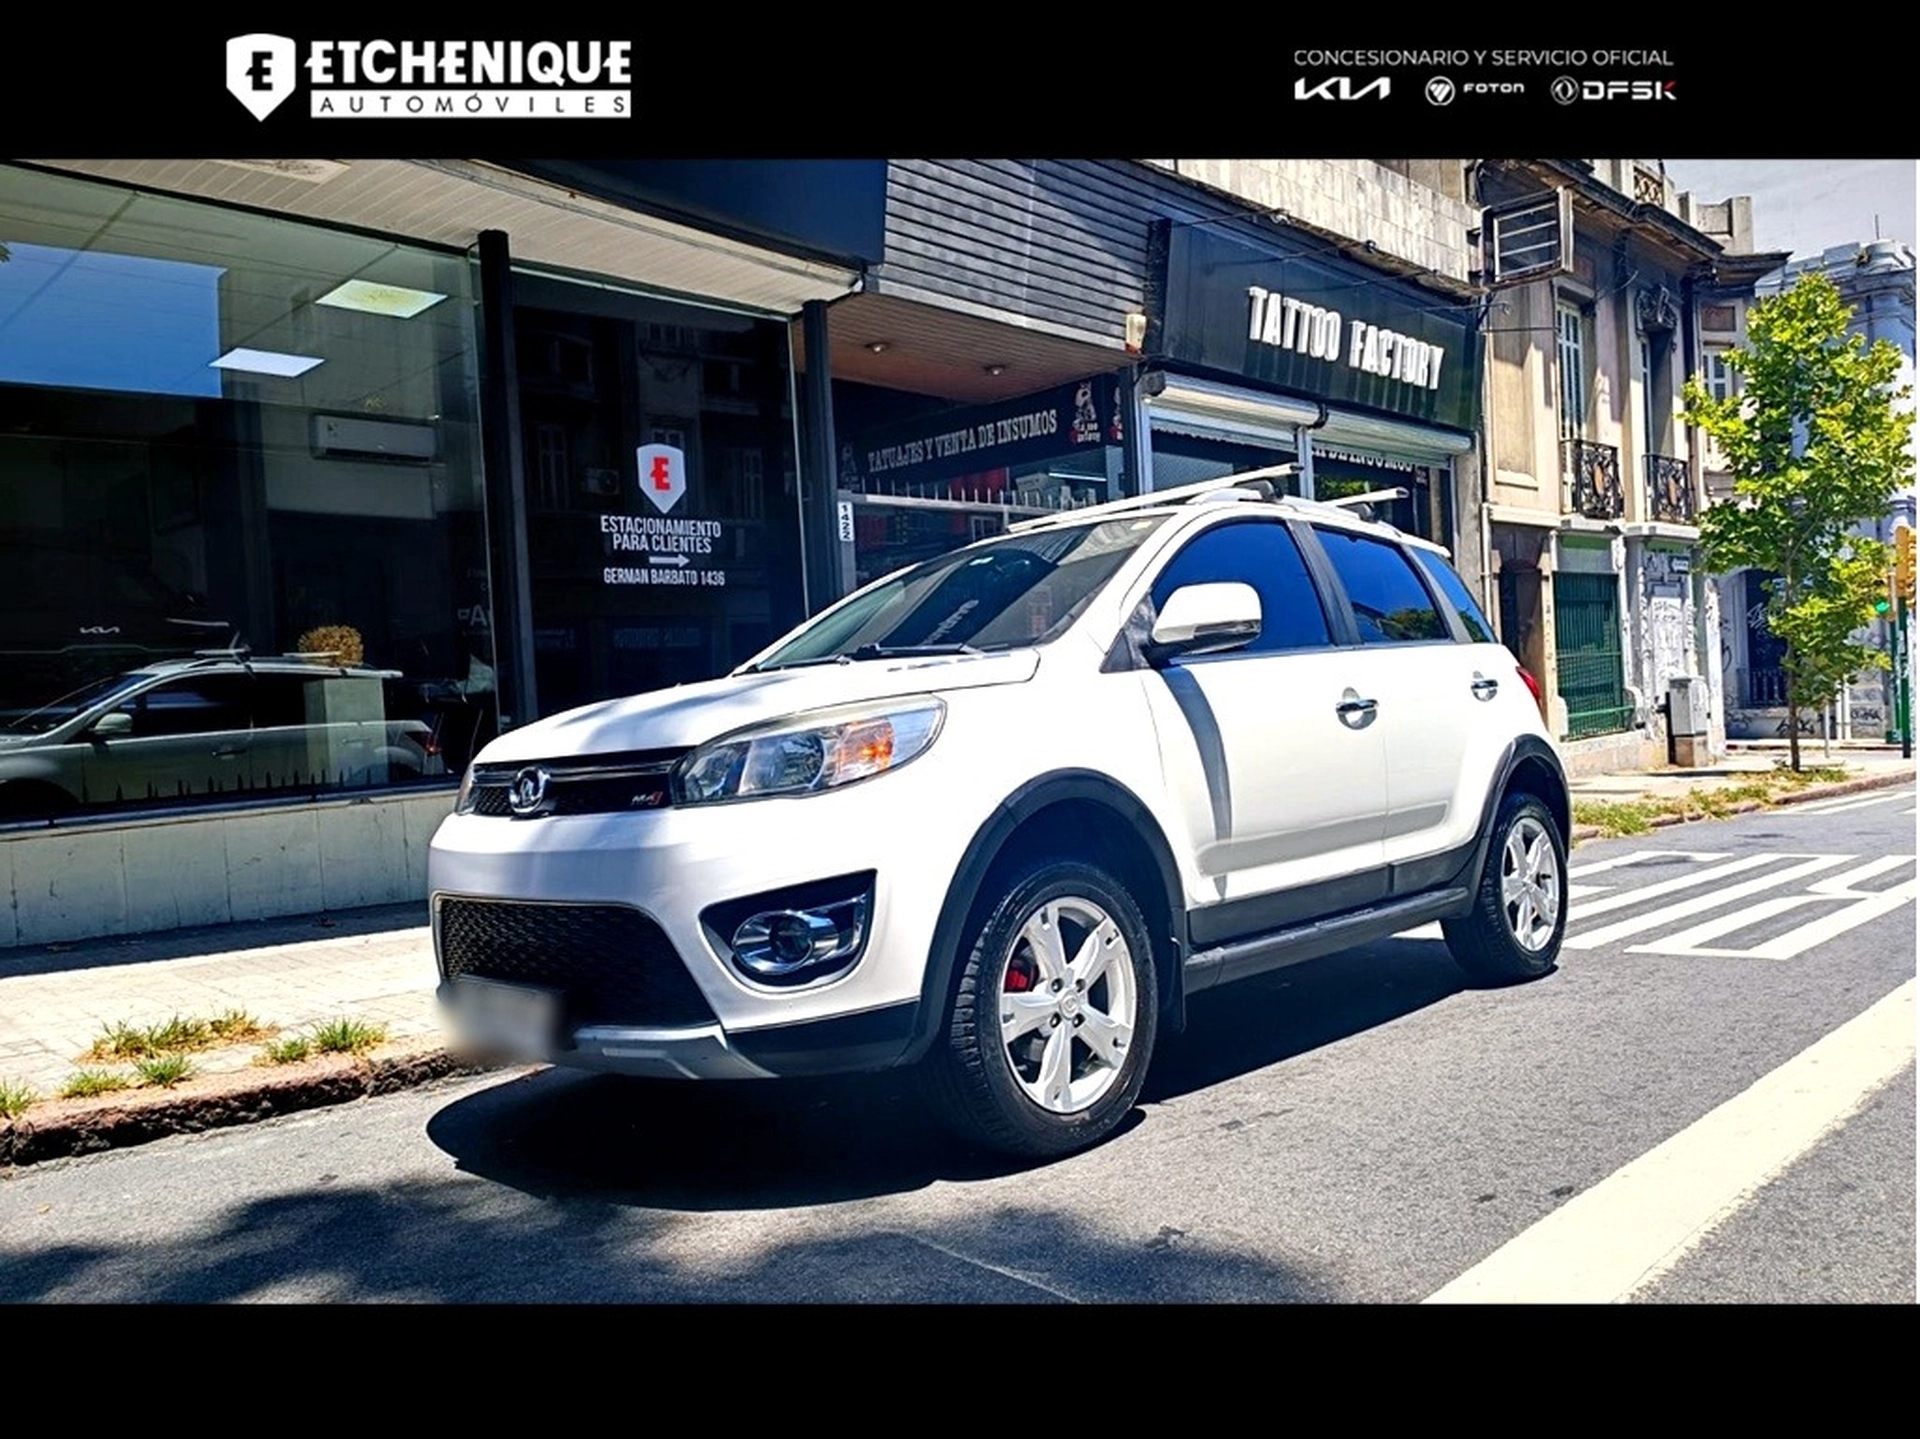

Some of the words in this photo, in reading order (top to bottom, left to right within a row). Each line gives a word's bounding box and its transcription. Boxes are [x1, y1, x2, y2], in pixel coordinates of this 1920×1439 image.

[1249, 286, 1342, 362] TATTOO
[1349, 319, 1444, 390] FACTORY
[868, 438, 923, 472] TATUAJES
[924, 437, 934, 460] Y
[935, 428, 976, 457] VENTA
[978, 423, 995, 448] DE
[997, 409, 1057, 444] INSUMOS
[601, 515, 721, 538] ESTACIONAMIENTO
[841, 504, 851, 540] 1422
[613, 534, 649, 551] PARA
[651, 535, 712, 553] CLIENTES
[603, 567, 649, 584] GERMAN
[650, 568, 698, 585] BARBATO
